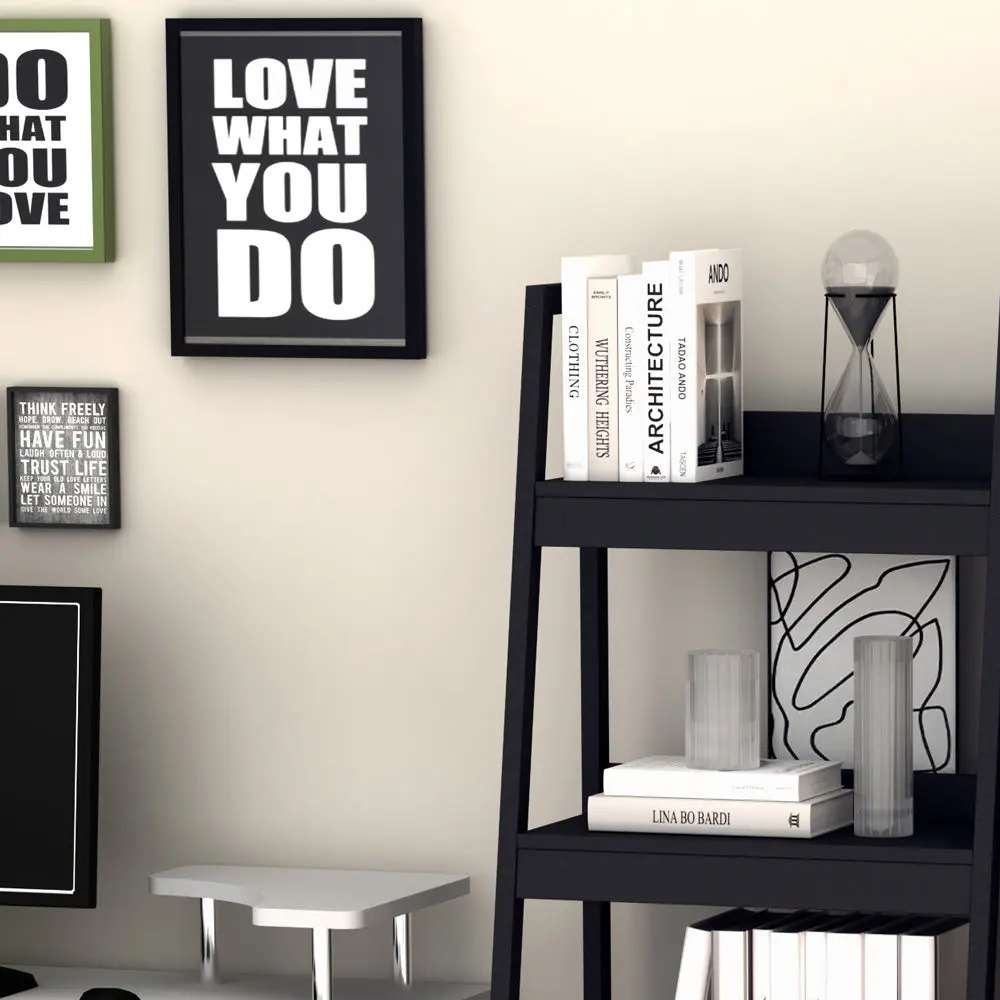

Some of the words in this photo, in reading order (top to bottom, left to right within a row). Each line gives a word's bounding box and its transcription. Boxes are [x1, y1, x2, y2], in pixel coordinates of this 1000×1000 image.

[0, 49, 68, 110] O
[213, 57, 368, 110] LOVE
[0, 116, 66, 141] HAT
[212, 115, 368, 156] WHAT
[0, 147, 67, 187] OU
[211, 161, 367, 224] YOU
[216, 227, 376, 321] DO
[708, 263, 729, 284] ANDO
[568, 325, 580, 399] CLOTHING
[623, 326, 634, 378] Constructing
[678, 337, 686, 370] TADAO
[595, 338, 609, 406] WUTHERING
[647, 283, 664, 454] ARCHITECTURE
[678, 373, 686, 400] ANDO
[19, 401, 57, 416] THINK
[61, 402, 106, 416] FREELY
[67, 416, 90, 424] REACH
[93, 416, 106, 425] OUT
[20, 430, 65, 448] HAVE
[72, 431, 106, 449] FUN
[595, 411, 610, 459] HEIGHTS
[19, 449, 45, 458] LAUGH
[49, 449, 75, 458] OFTEN
[77, 450, 84, 458] &
[86, 450, 107, 459] LOUD
[20, 459, 69, 475] TRUST
[75, 460, 107, 476] LIFE
[20, 482, 52, 494] WEAR
[59, 482, 66, 494] A
[73, 483, 107, 495] SMILE
[20, 494, 40, 505] LET
[44, 495, 93, 506] SOMEONE
[96, 495, 107, 507] IN
[36, 506, 49, 514] THE
[51, 506, 72, 514] WORLD
[652, 810, 678, 824] LINA
[680, 811, 695, 825] BO
[697, 811, 731, 826] BARDI
